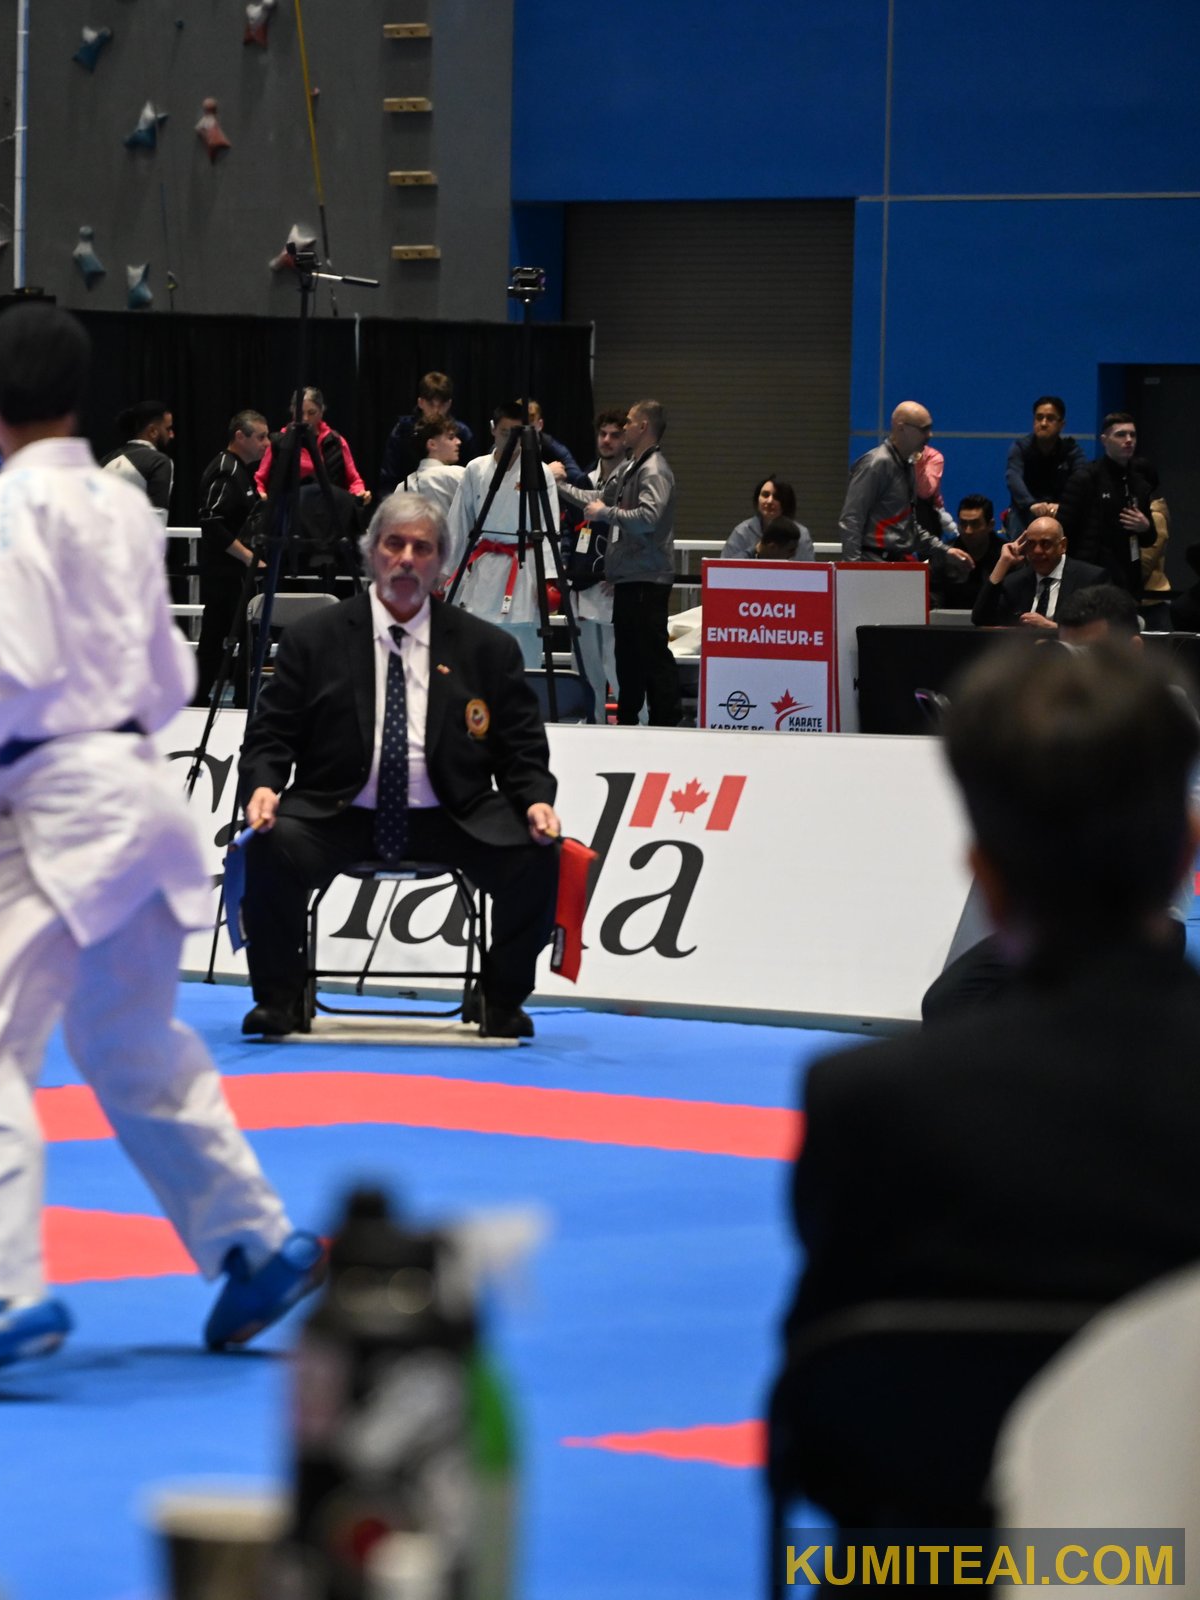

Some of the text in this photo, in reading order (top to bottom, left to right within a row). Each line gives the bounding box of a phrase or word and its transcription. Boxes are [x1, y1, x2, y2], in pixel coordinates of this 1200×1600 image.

[738, 602, 796, 618] COACH
[707, 625, 824, 646] ENTRAÎNEUR·E
[788, 716, 823, 728] KARATE
